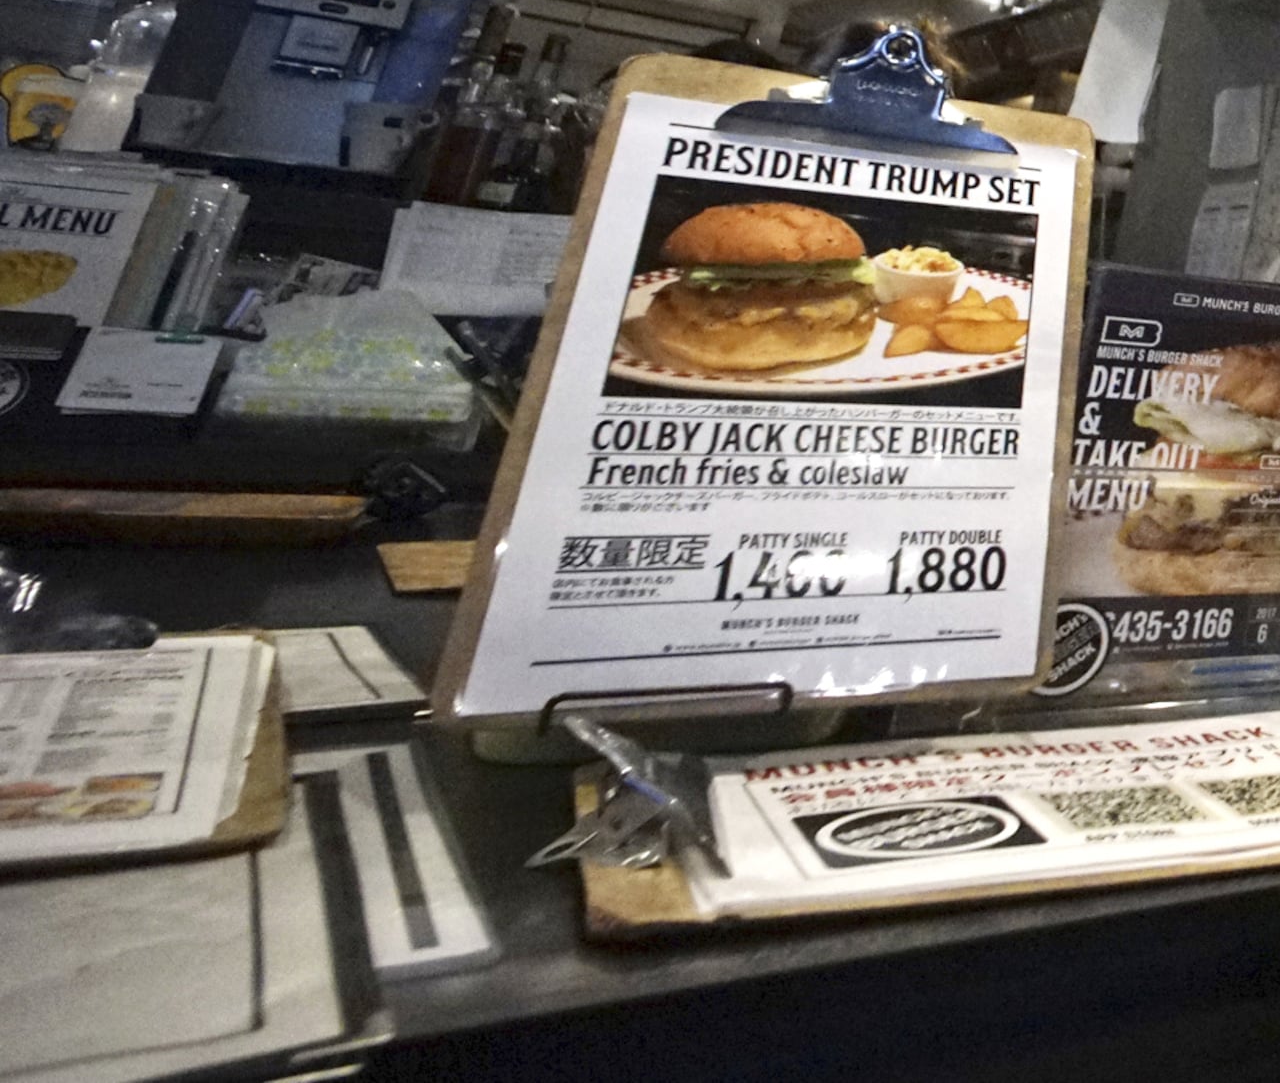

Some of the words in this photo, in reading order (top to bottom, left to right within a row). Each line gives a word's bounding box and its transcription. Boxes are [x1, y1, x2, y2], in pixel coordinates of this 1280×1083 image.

[662, 136, 859, 188] PRESIDENT
[868, 161, 980, 200] TRUMP
[987, 176, 1041, 207] SET
[20, 204, 117, 236] MENU
[1202, 296, 1250, 313] MUNCH'S
[1096, 345, 1145, 362] MUNCH'S
[1146, 351, 1188, 365] BURGER
[1188, 354, 1224, 367] SHACK
[1087, 364, 1222, 405] DELIVERY
[1078, 401, 1102, 435] &
[592, 419, 703, 451] COLBY
[705, 422, 788, 455] JACK
[794, 424, 903, 455] CHEESE
[910, 427, 1019, 455] BURGER
[586, 456, 689, 486] French
[695, 458, 760, 486] fries
[767, 458, 789, 486] &
[799, 460, 909, 486] coleslaw
[1069, 478, 1151, 511] MENU
[557, 536, 711, 569] 数量限定
[738, 533, 791, 550] PATTY
[793, 532, 848, 549] SINGLE
[900, 531, 946, 546] PATTY
[948, 529, 1002, 545] DOUBLE
[885, 546, 1006, 603] 1,880
[1105, 607, 1234, 643] 435-3166
[1257, 623, 1268, 644] 6
[1048, 642, 1096, 683] SHACK
[974, 739, 1140, 758] BURGER
[1147, 726, 1273, 749] SHACK
